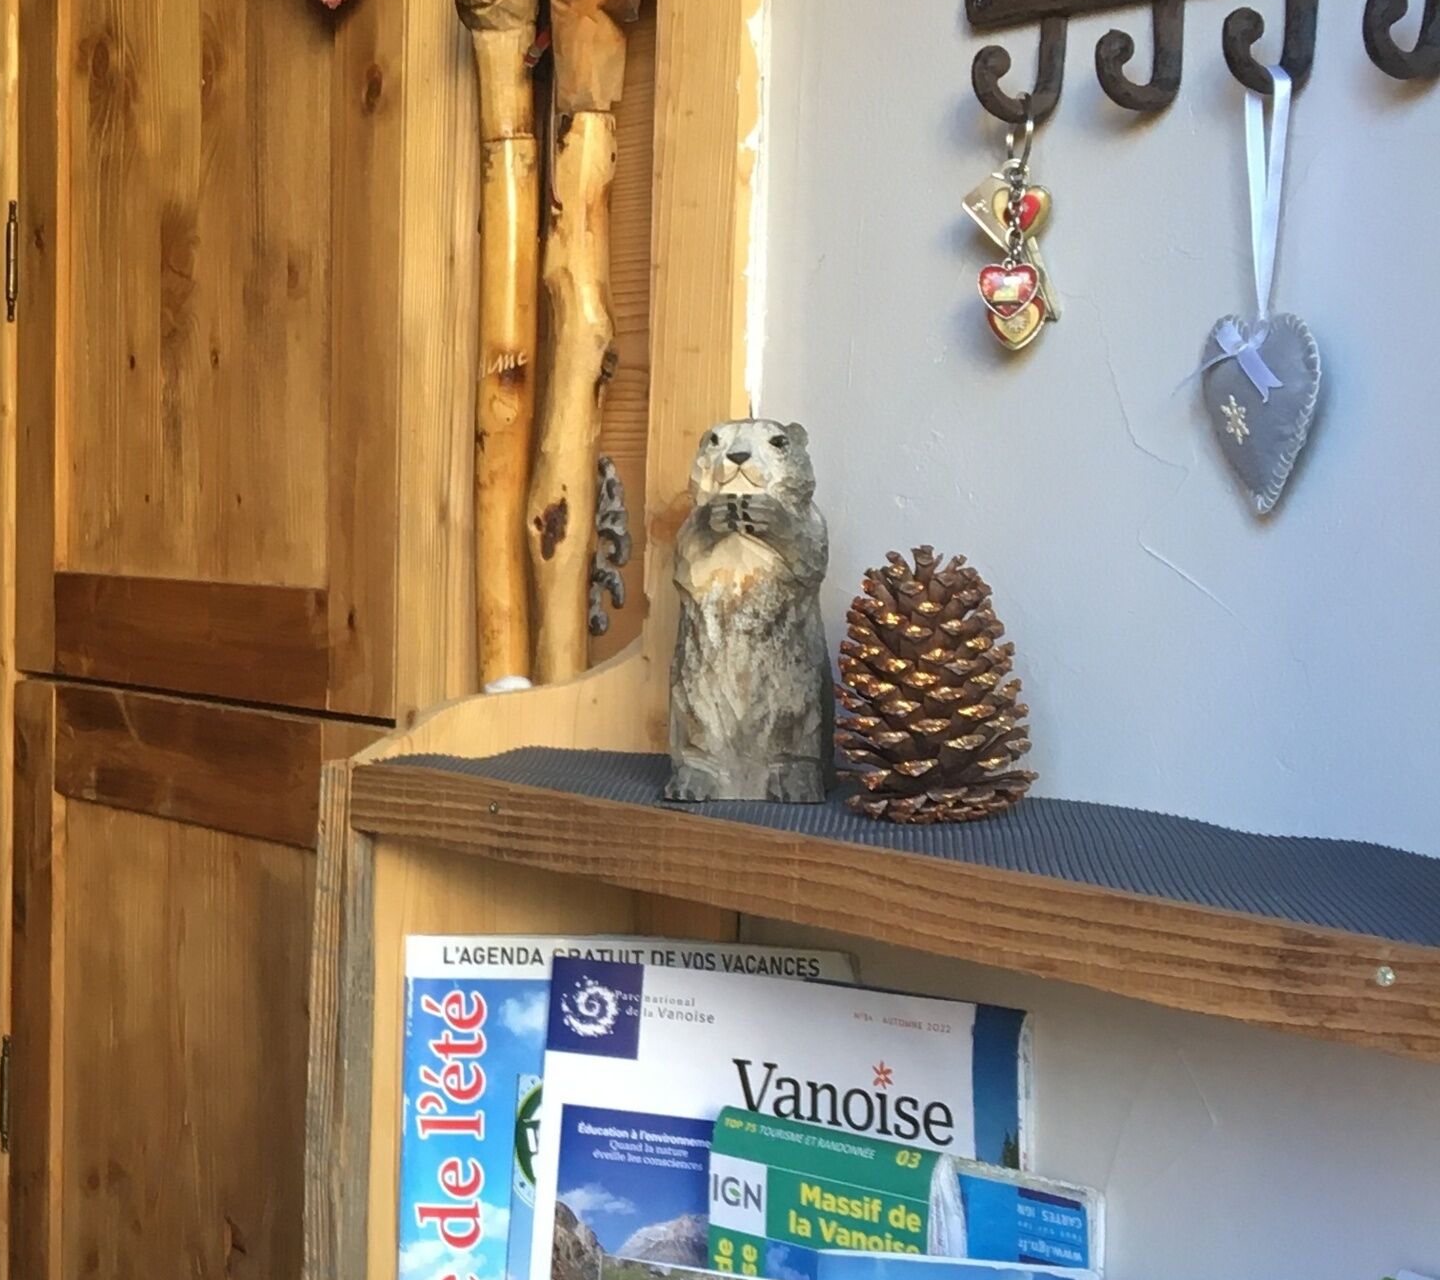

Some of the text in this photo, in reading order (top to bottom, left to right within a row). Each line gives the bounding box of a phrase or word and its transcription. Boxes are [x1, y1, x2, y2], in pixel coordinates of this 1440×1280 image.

[443, 946, 545, 966] L'AGENDA
[651, 950, 676, 968] DE
[681, 952, 716, 971] VOS
[721, 954, 820, 978] VACANCES
[626, 1004, 716, 1024] de la Vanoise
[644, 993, 695, 1007] national
[416, 988, 488, 1140] l'été
[732, 1057, 955, 1147] Vanoise
[577, 1121, 629, 1139] Éducation
[759, 1125, 804, 1144] TOURISME
[805, 1135, 817, 1147] ET
[895, 1150, 922, 1169] 03
[644, 1143, 655, 1154] la
[655, 1145, 689, 1159] nature
[417, 1157, 485, 1250] de
[712, 1173, 763, 1214] IGN
[800, 1182, 921, 1233] Massif de
[789, 1209, 811, 1238] la
